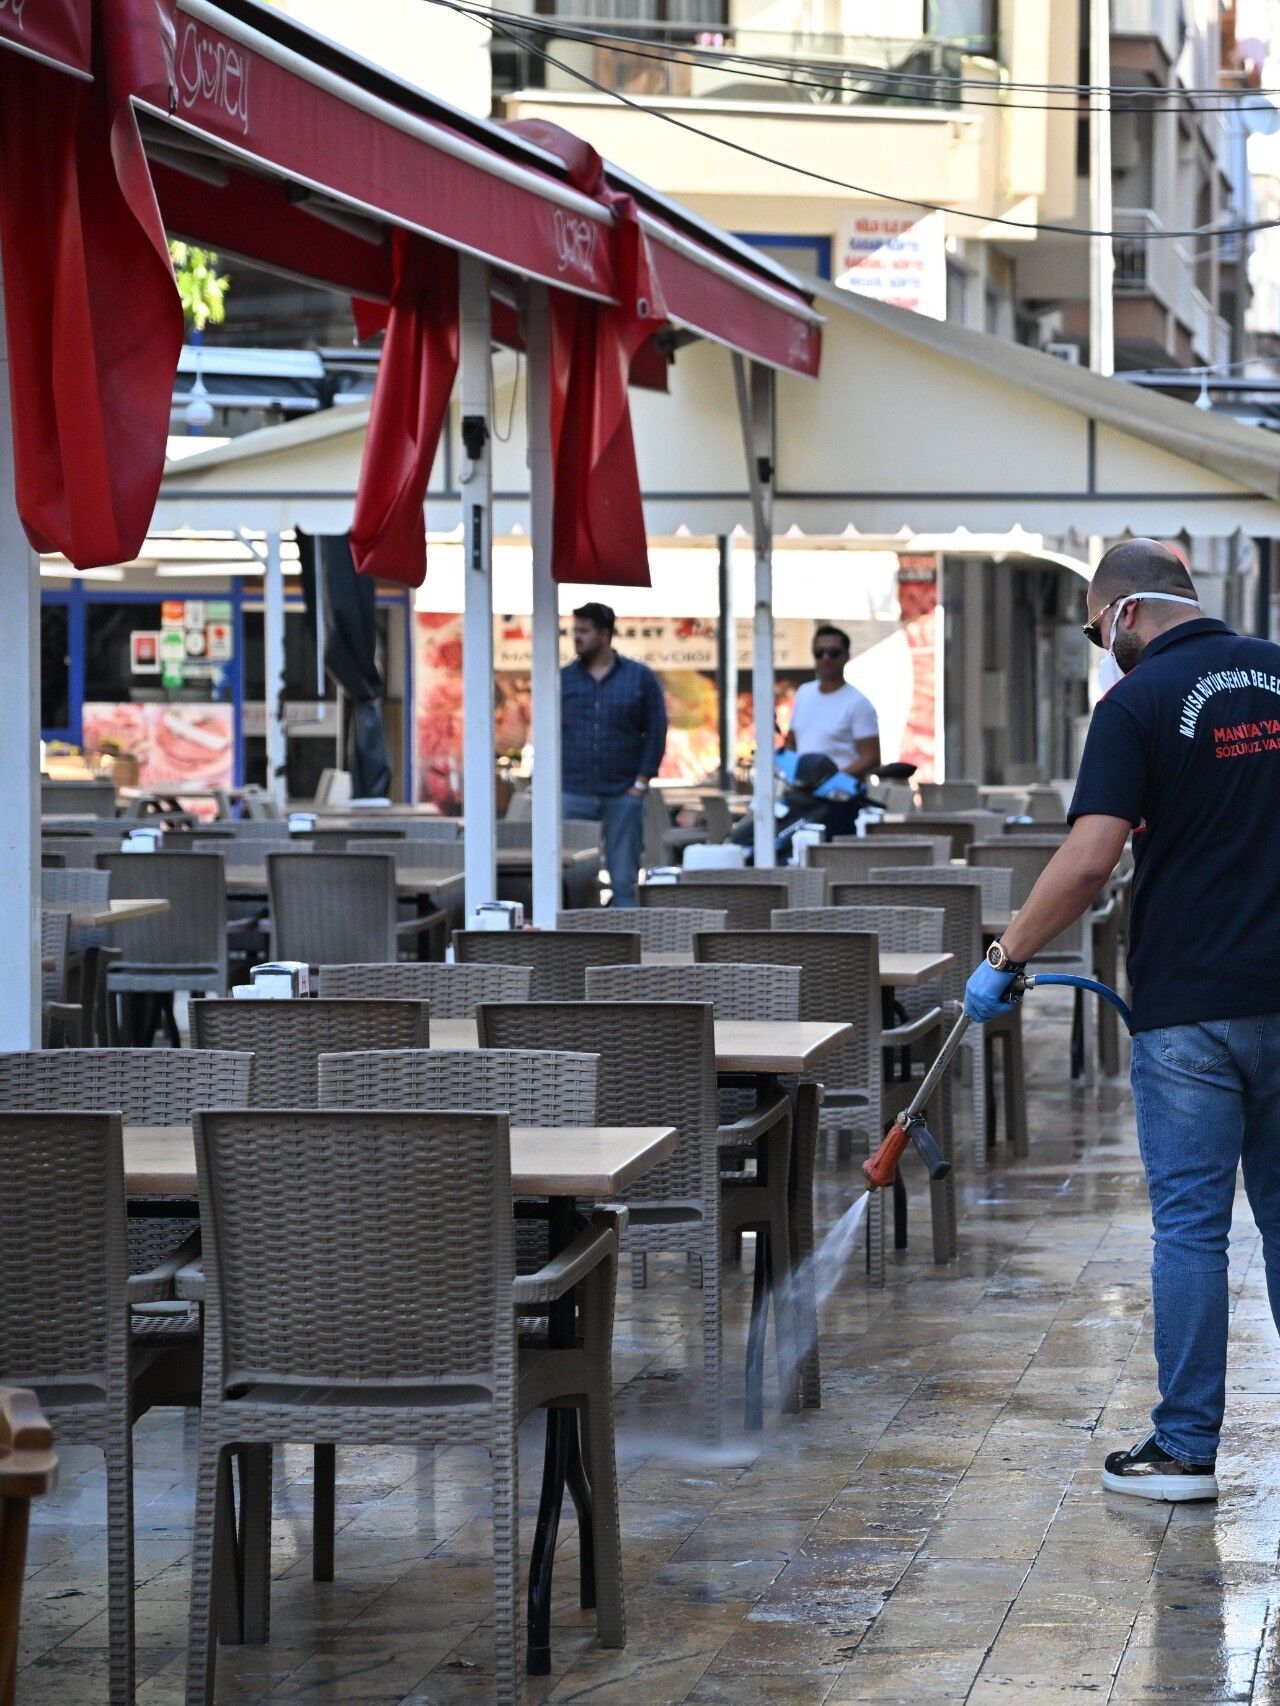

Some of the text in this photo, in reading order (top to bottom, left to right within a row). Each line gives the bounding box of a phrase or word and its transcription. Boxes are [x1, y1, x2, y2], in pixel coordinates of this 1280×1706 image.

[180, 22, 249, 135] güney
[1179, 690, 1207, 739] MANİSA
[1196, 667, 1251, 698] BÜYÜKŞEHİR
